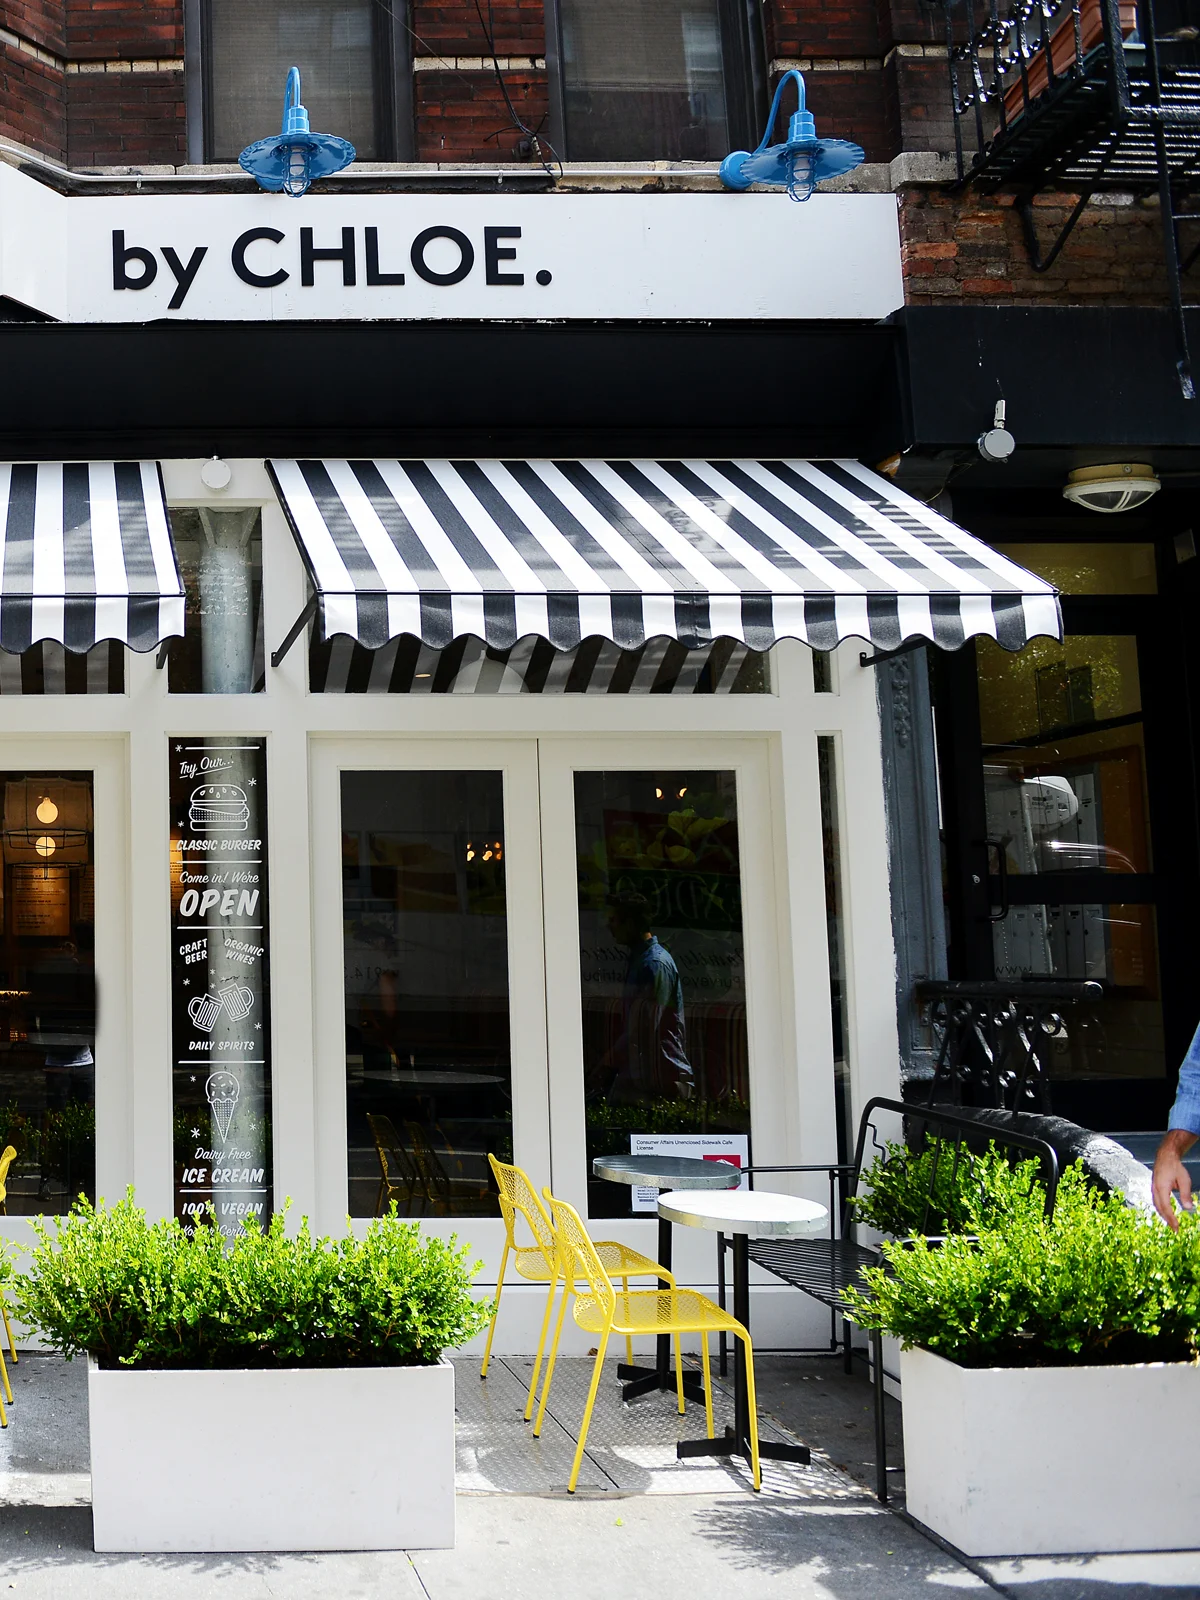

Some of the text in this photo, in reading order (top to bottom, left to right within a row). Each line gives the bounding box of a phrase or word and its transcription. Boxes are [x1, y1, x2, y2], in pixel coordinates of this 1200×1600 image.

[112, 225, 553, 309] by CHLOE.
[179, 761, 198, 778] Try
[176, 839, 262, 851] CLASSIC BURGER
[179, 871, 209, 884] Come
[211, 871, 228, 884] in!
[179, 888, 260, 917] OPEN
[179, 938, 208, 955] CRAFT
[224, 938, 265, 957] ORGANIC
[185, 950, 208, 965] BEER
[225, 949, 255, 965] WINES
[188, 1041, 255, 1051] DAILY SPIRITS
[194, 1147, 252, 1165] Dairy Free
[182, 1168, 265, 1183] ICE CREAM
[221, 1202, 264, 1216] VEGAN
